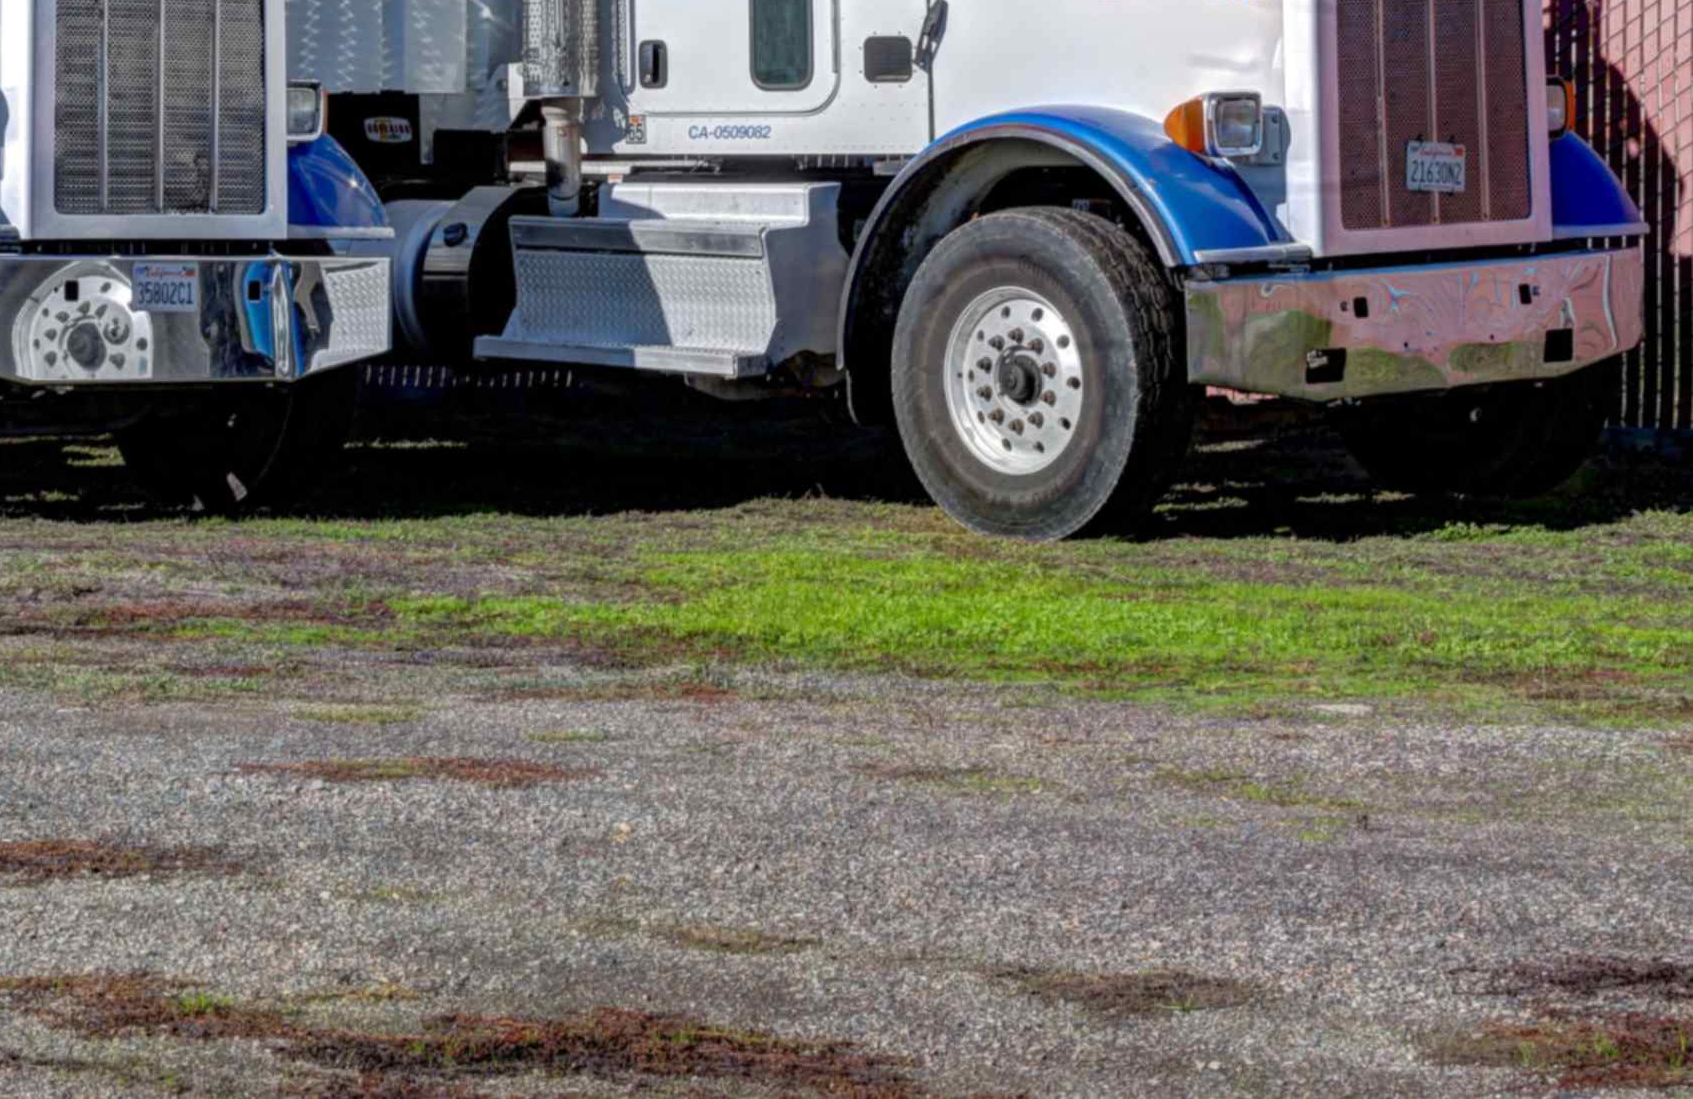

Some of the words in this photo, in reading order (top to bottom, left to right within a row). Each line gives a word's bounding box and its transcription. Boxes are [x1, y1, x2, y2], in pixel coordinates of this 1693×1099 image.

[688, 124, 771, 140] CA-0509082
[1410, 159, 1462, 186] 21630N2
[137, 281, 194, 305] 35802C1
